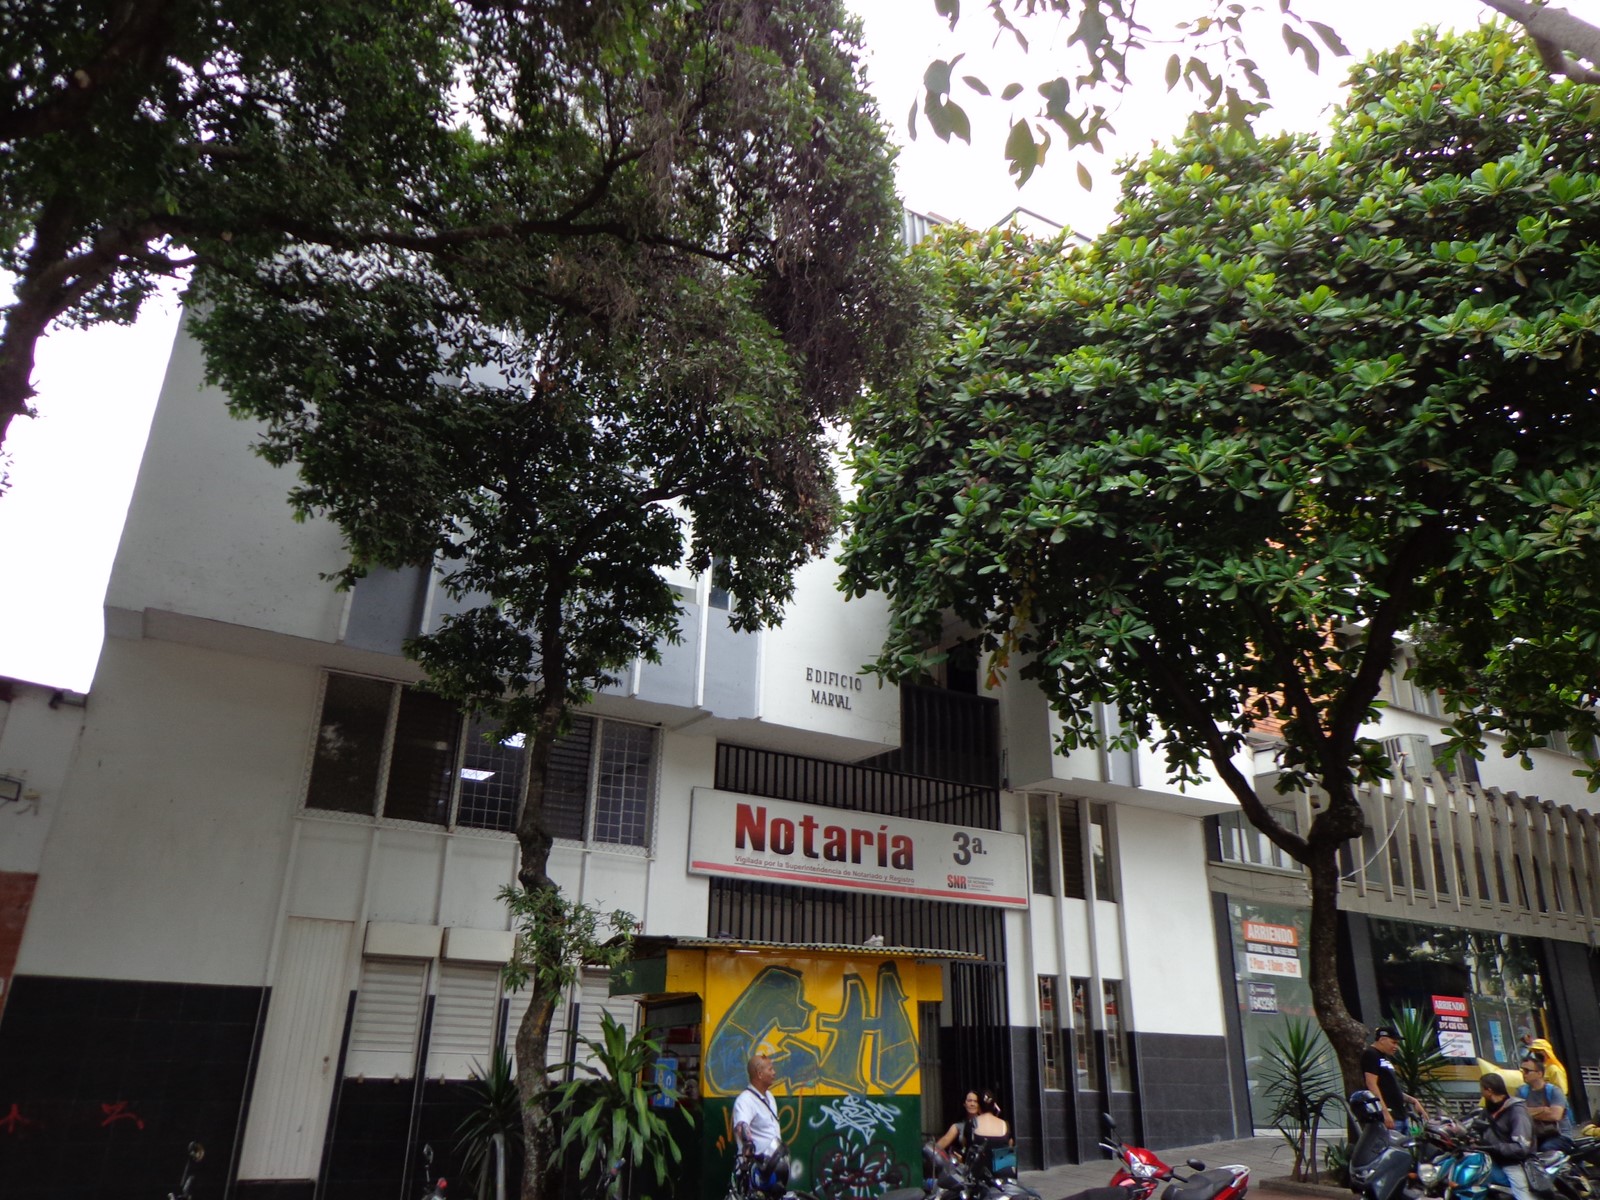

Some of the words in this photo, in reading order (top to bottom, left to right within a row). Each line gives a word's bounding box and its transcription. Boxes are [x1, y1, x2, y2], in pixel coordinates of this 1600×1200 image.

[806, 667, 862, 691] EDIFICIO
[811, 689, 852, 711] MARVAL
[735, 803, 914, 871] Notaría
[735, 855, 762, 866] Vigilada
[764, 860, 776, 868] por
[784, 861, 842, 876] Superintendencia
[843, 868, 851, 876] de
[852, 869, 883, 880] Notariado
[889, 874, 915, 885] Registro
[947, 874, 967, 890] SNR
[1248, 923, 1294, 944] ARRIENDO
[1434, 1000, 1466, 1012] ARRIENDO
